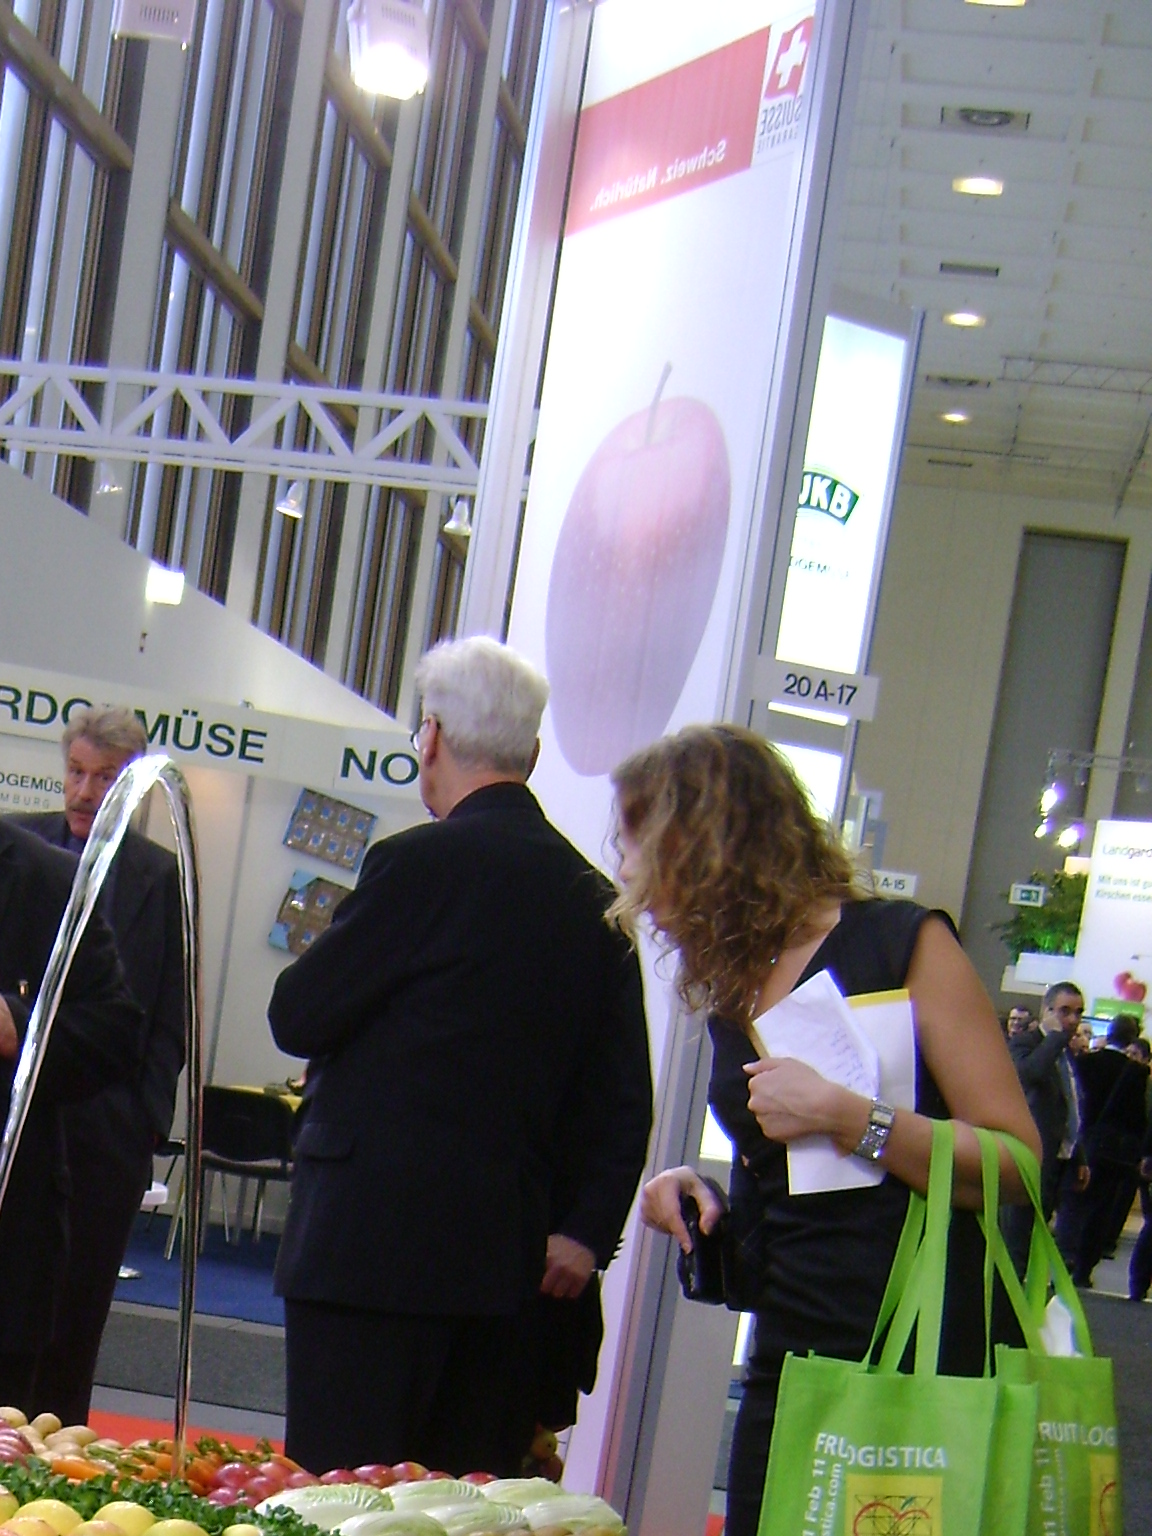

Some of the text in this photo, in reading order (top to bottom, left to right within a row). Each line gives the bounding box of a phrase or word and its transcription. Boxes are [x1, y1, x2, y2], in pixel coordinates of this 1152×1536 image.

[783, 673, 858, 706] 20 A-17
[813, 1458, 826, 1478] 11
[805, 1485, 823, 1523] Feb
